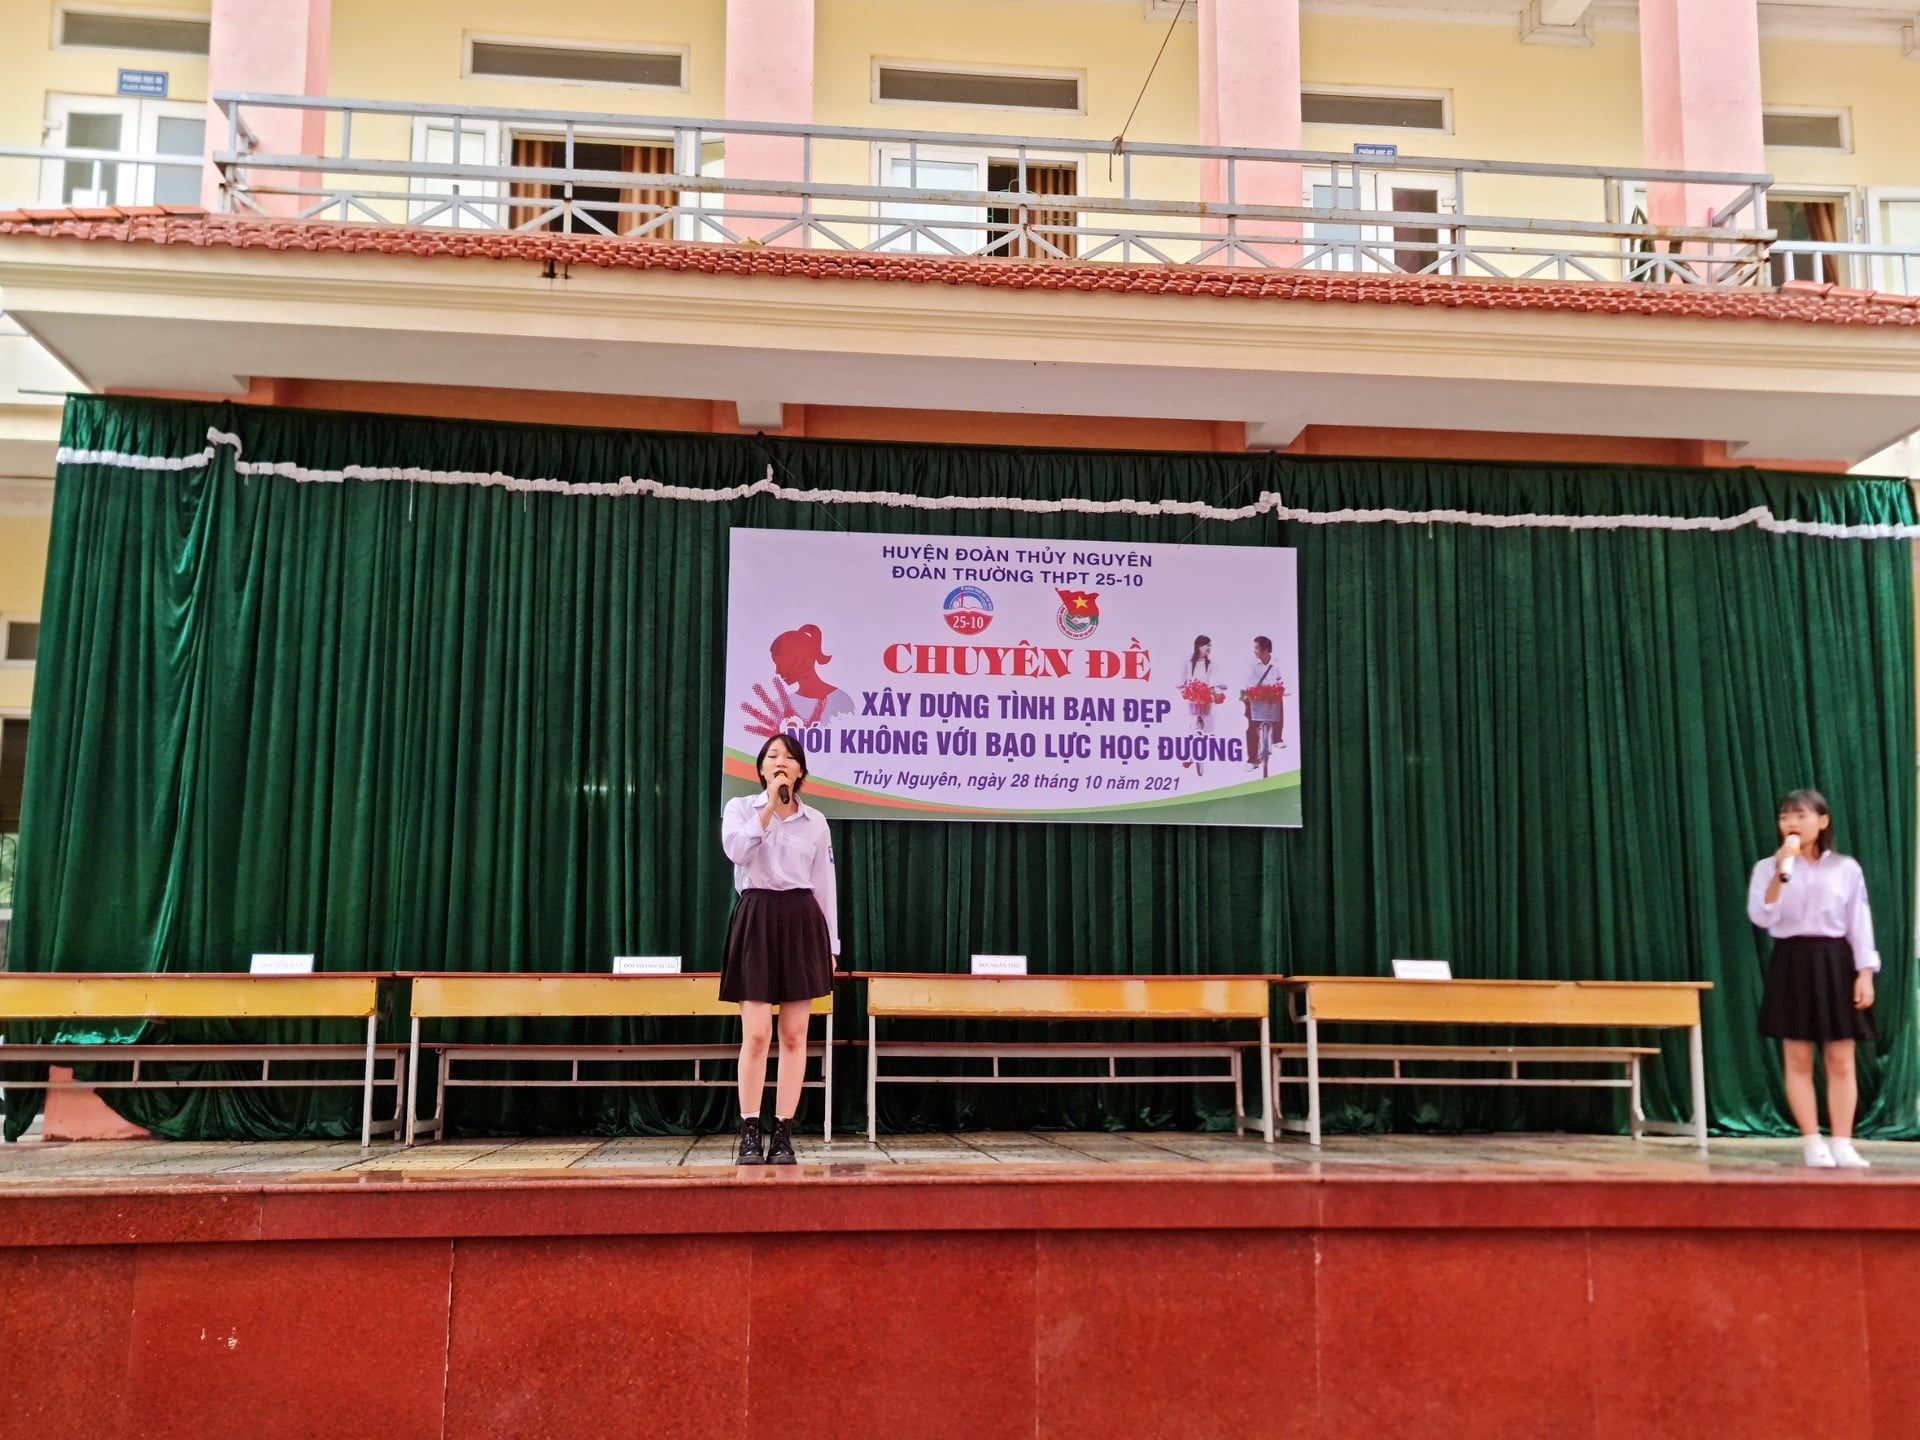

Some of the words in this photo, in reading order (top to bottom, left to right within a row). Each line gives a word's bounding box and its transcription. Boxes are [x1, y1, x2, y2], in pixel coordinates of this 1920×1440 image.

[883, 544, 948, 562] HUYỆN
[955, 546, 1009, 562] ĐOÀN
[1015, 546, 1066, 564] THỦY
[1073, 551, 1152, 567] NGUYÊN
[892, 563, 946, 580] ĐOÀN
[953, 565, 1033, 583] TRƯỜNG
[1040, 570, 1089, 584] THPT
[1095, 573, 1143, 587] 25-10
[953, 615, 984, 629] 25-10
[883, 640, 1073, 678] CHUYÊN
[1085, 637, 1151, 682] ĐỀ
[862, 687, 911, 717] XÂY
[920, 691, 989, 723] DỰNG
[998, 690, 1055, 720] TÌNH
[1063, 697, 1115, 727] BẠN
[1123, 699, 1171, 728] ĐẸP
[840, 725, 928, 755] KHÔNG
[937, 726, 976, 756] VỚI
[985, 731, 1036, 762] BẠO
[1045, 731, 1091, 763] LỰC
[1100, 735, 1149, 765] HỌC
[1157, 731, 1243, 762] ĐƯỜNG
[853, 769, 892, 787] Thủy
[896, 771, 962, 790] Nguyên,
[967, 774, 1006, 790] ngày
[1010, 773, 1029, 788] 28
[1034, 774, 1079, 792] tháng
[1085, 775, 1102, 789] 10
[1106, 776, 1140, 790] năm
[1144, 777, 1180, 791] 2021
